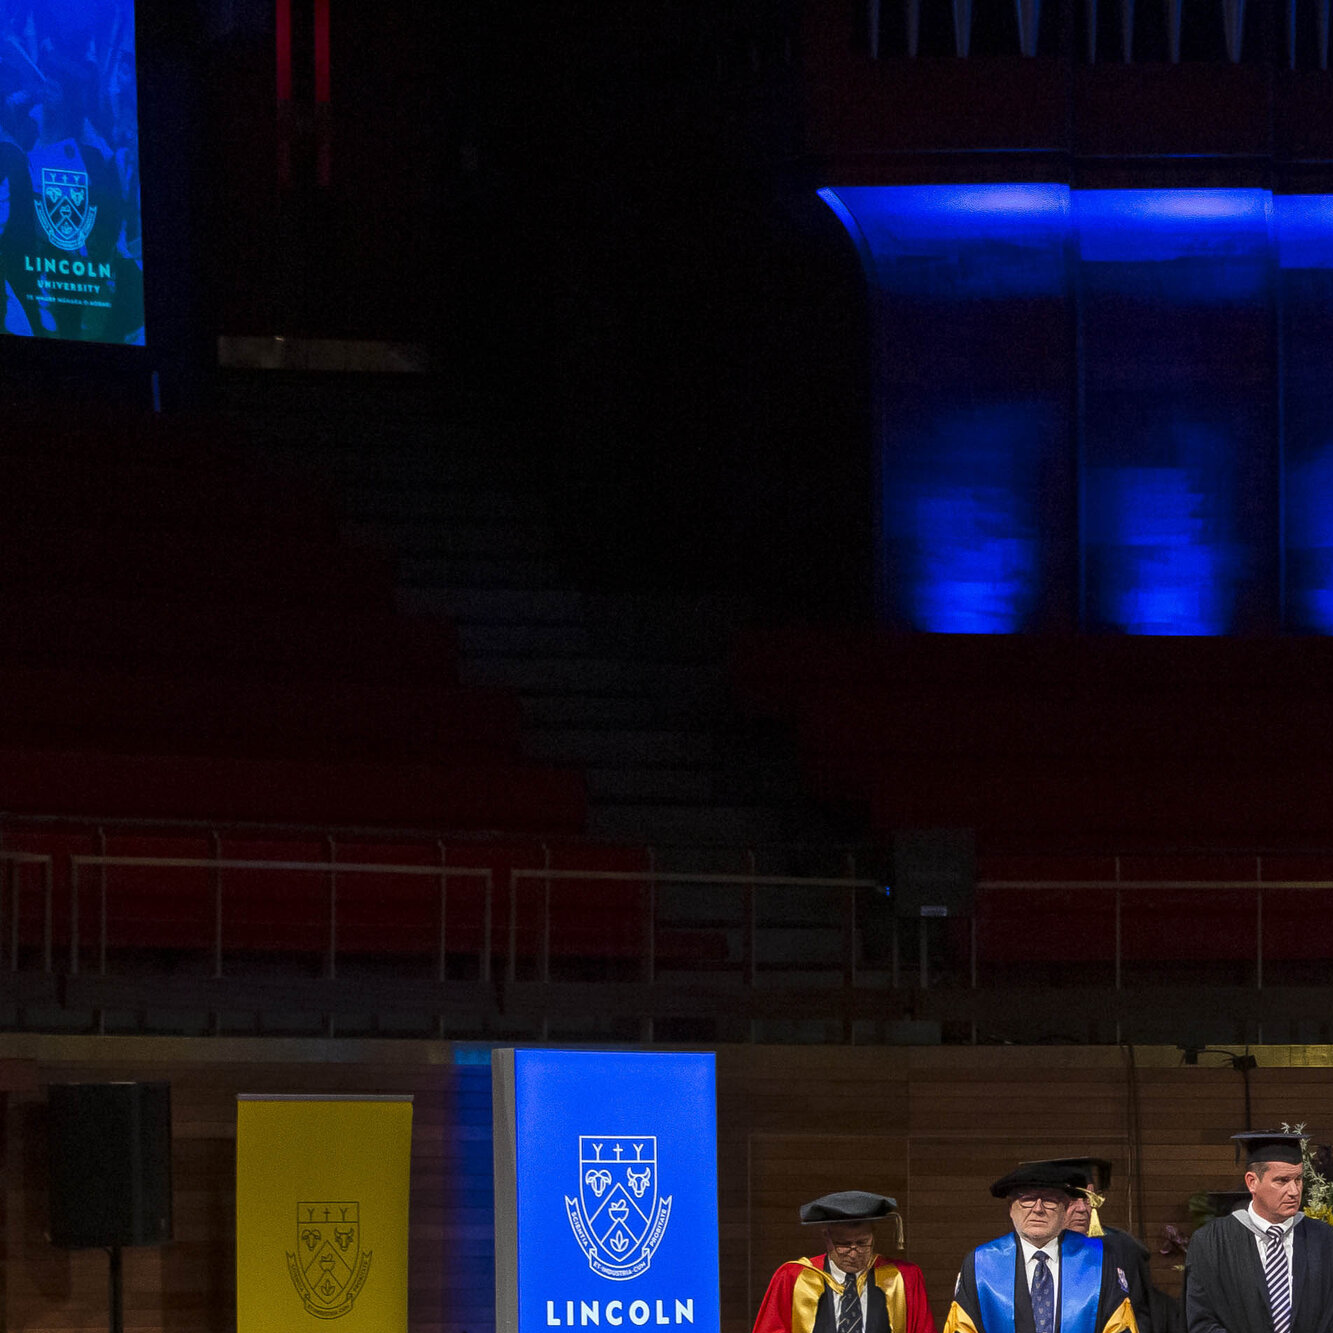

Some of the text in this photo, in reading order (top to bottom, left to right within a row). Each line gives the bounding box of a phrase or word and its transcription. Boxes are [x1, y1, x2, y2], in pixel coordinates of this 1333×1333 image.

[25, 255, 112, 279] LINCOLN
[37, 280, 101, 294] UNIVERSITY
[547, 1298, 694, 1326] LINCOLN
